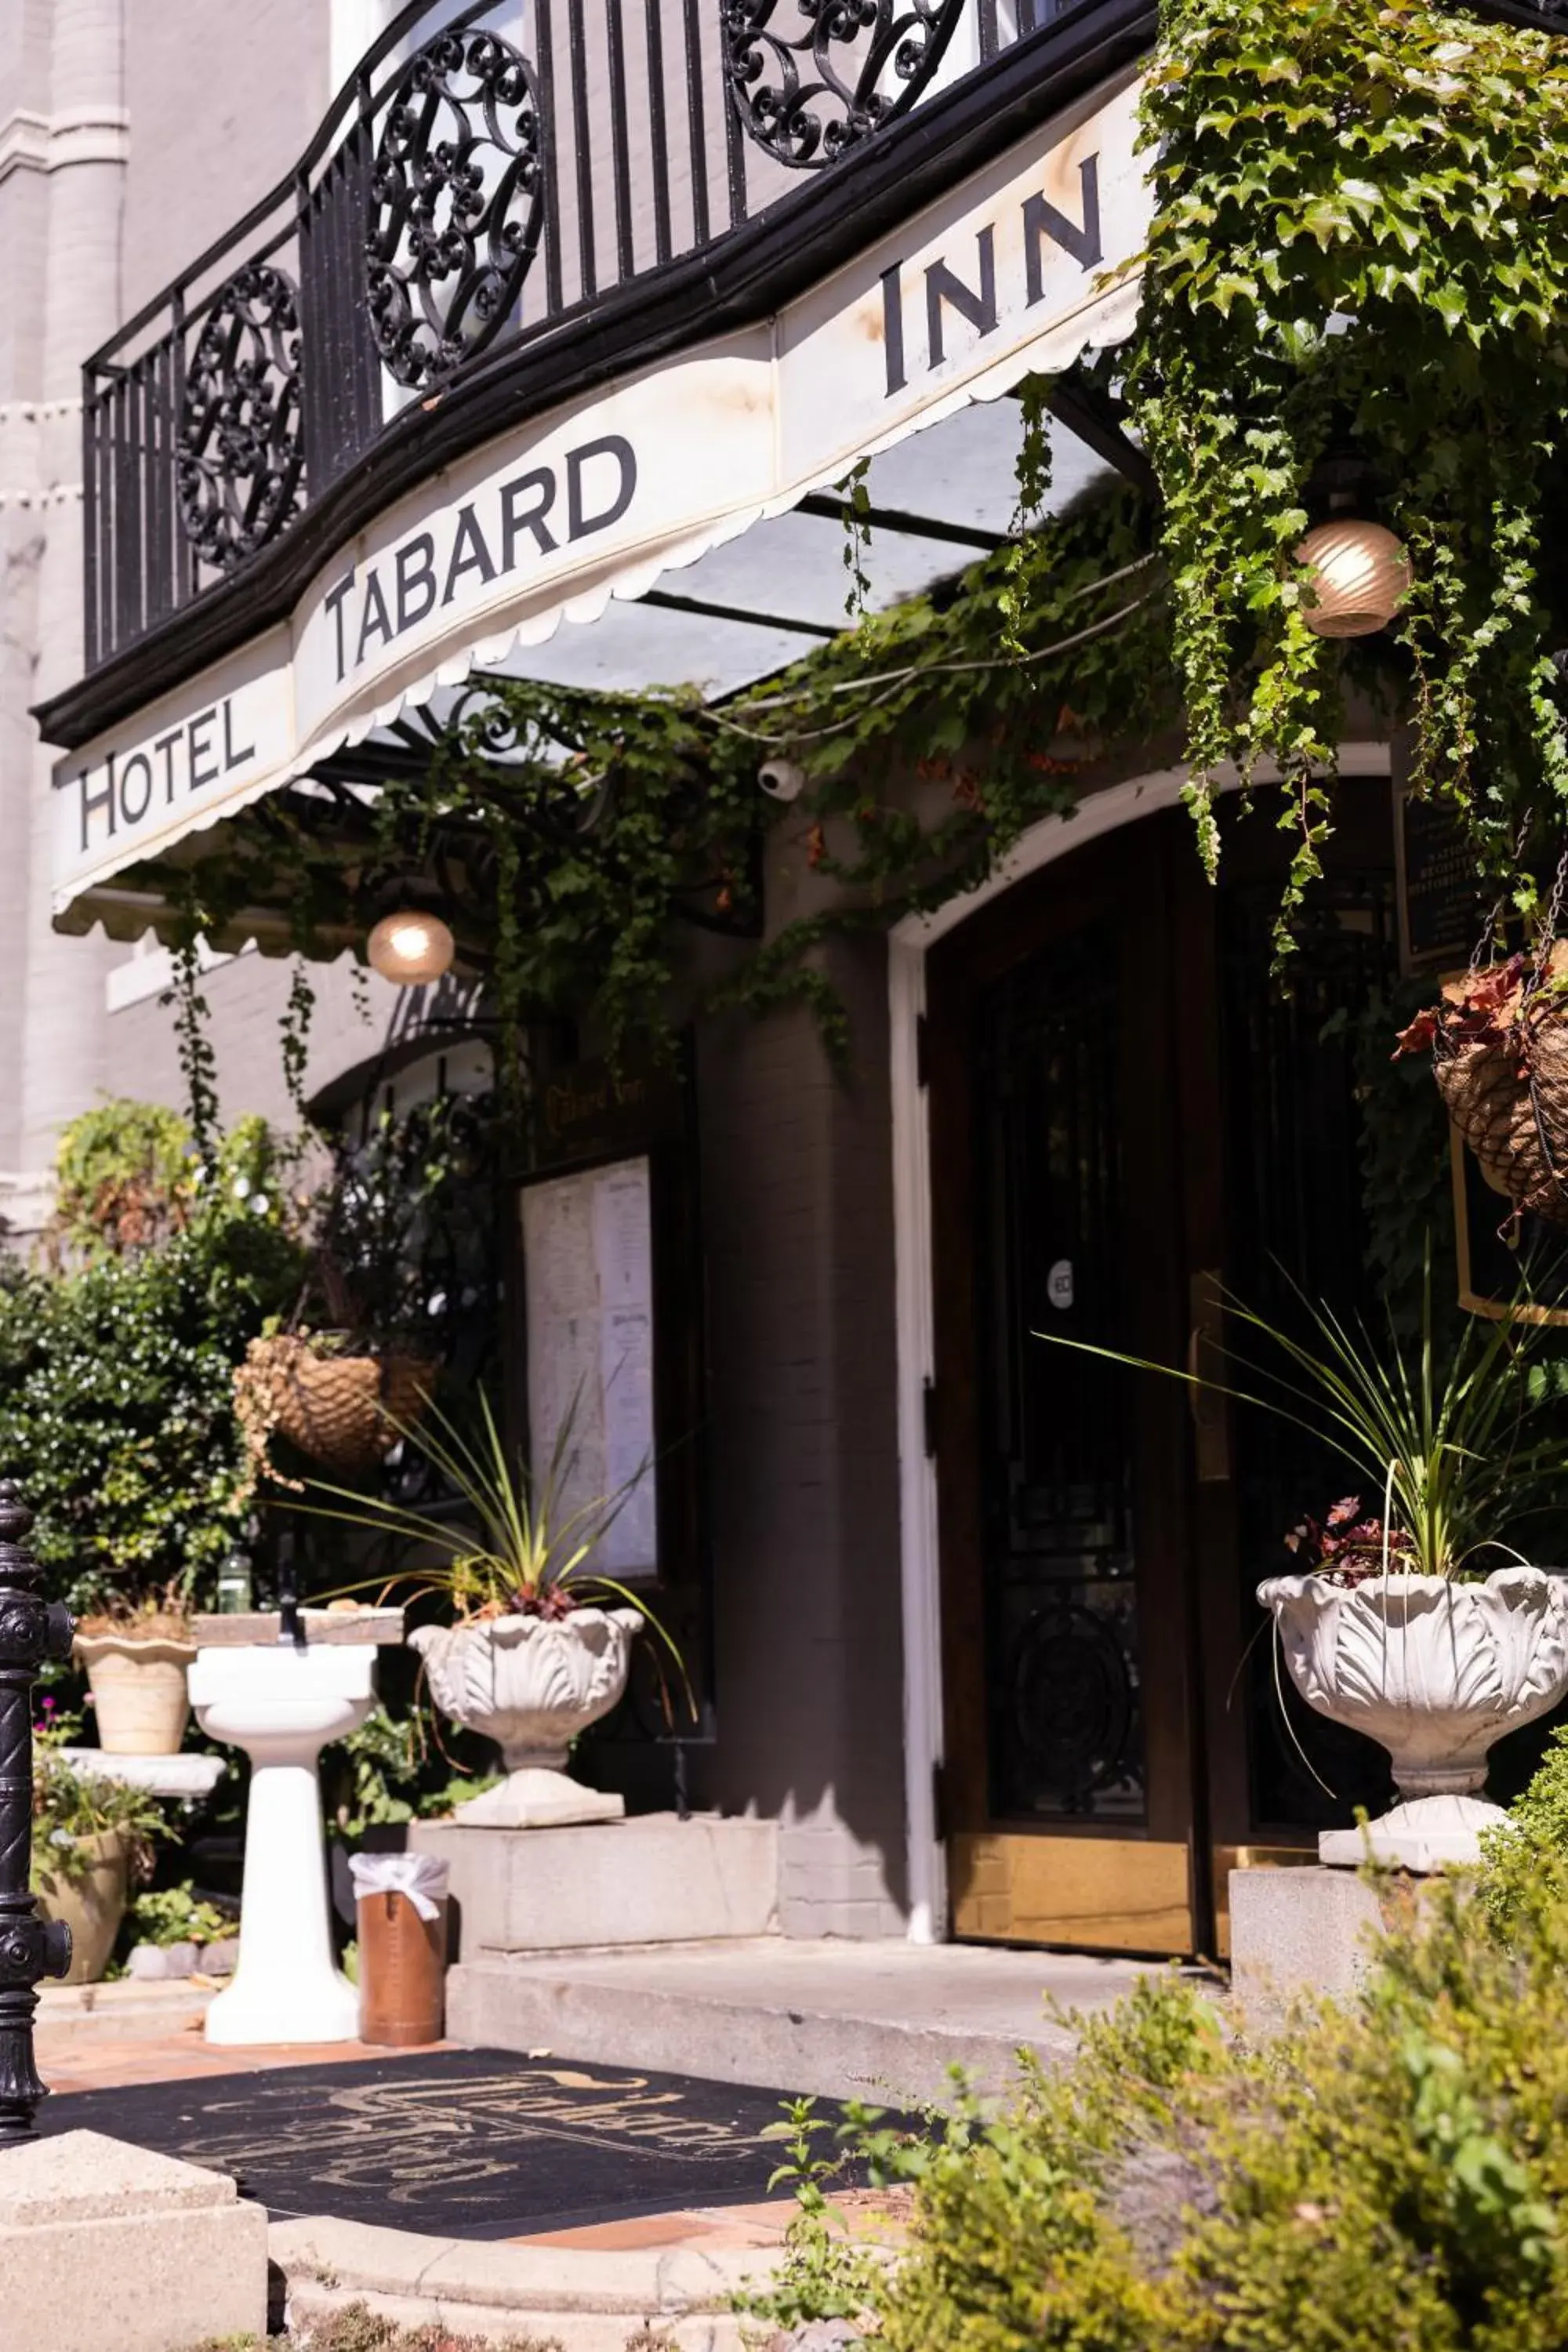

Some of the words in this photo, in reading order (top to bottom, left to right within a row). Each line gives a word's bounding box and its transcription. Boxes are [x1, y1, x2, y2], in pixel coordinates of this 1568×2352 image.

[80, 698, 255, 852] HOTEL
[325, 434, 637, 684] TABARD
[880, 151, 1104, 398] INN
